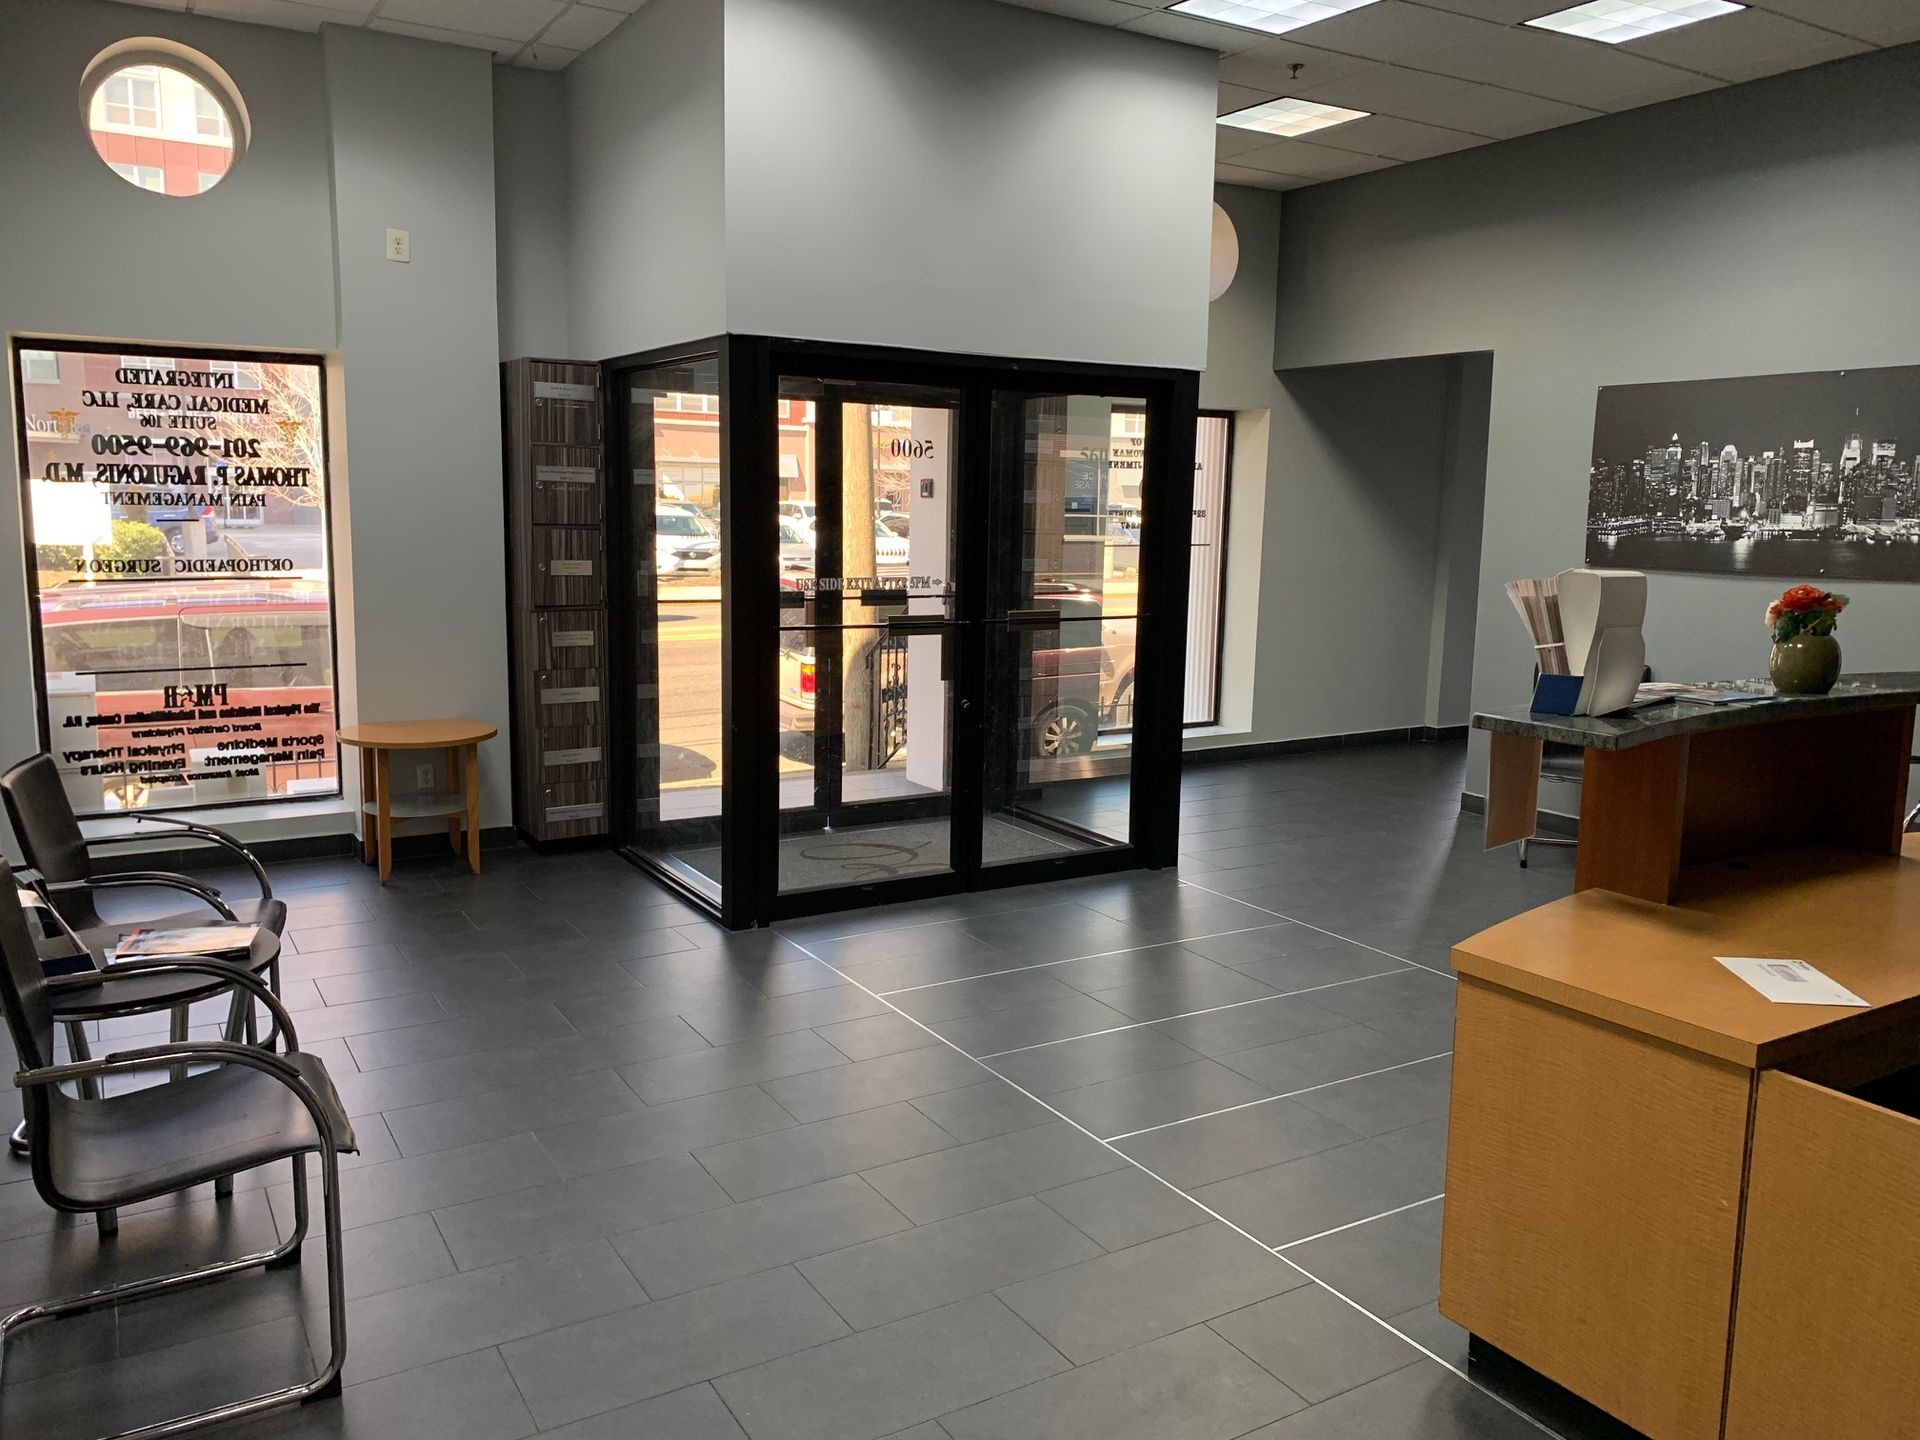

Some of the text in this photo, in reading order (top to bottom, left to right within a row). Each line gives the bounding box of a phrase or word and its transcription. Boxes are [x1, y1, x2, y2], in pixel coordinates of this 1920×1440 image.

[795, 576, 931, 591] USE SIDE EXIT AFTER 5PM
